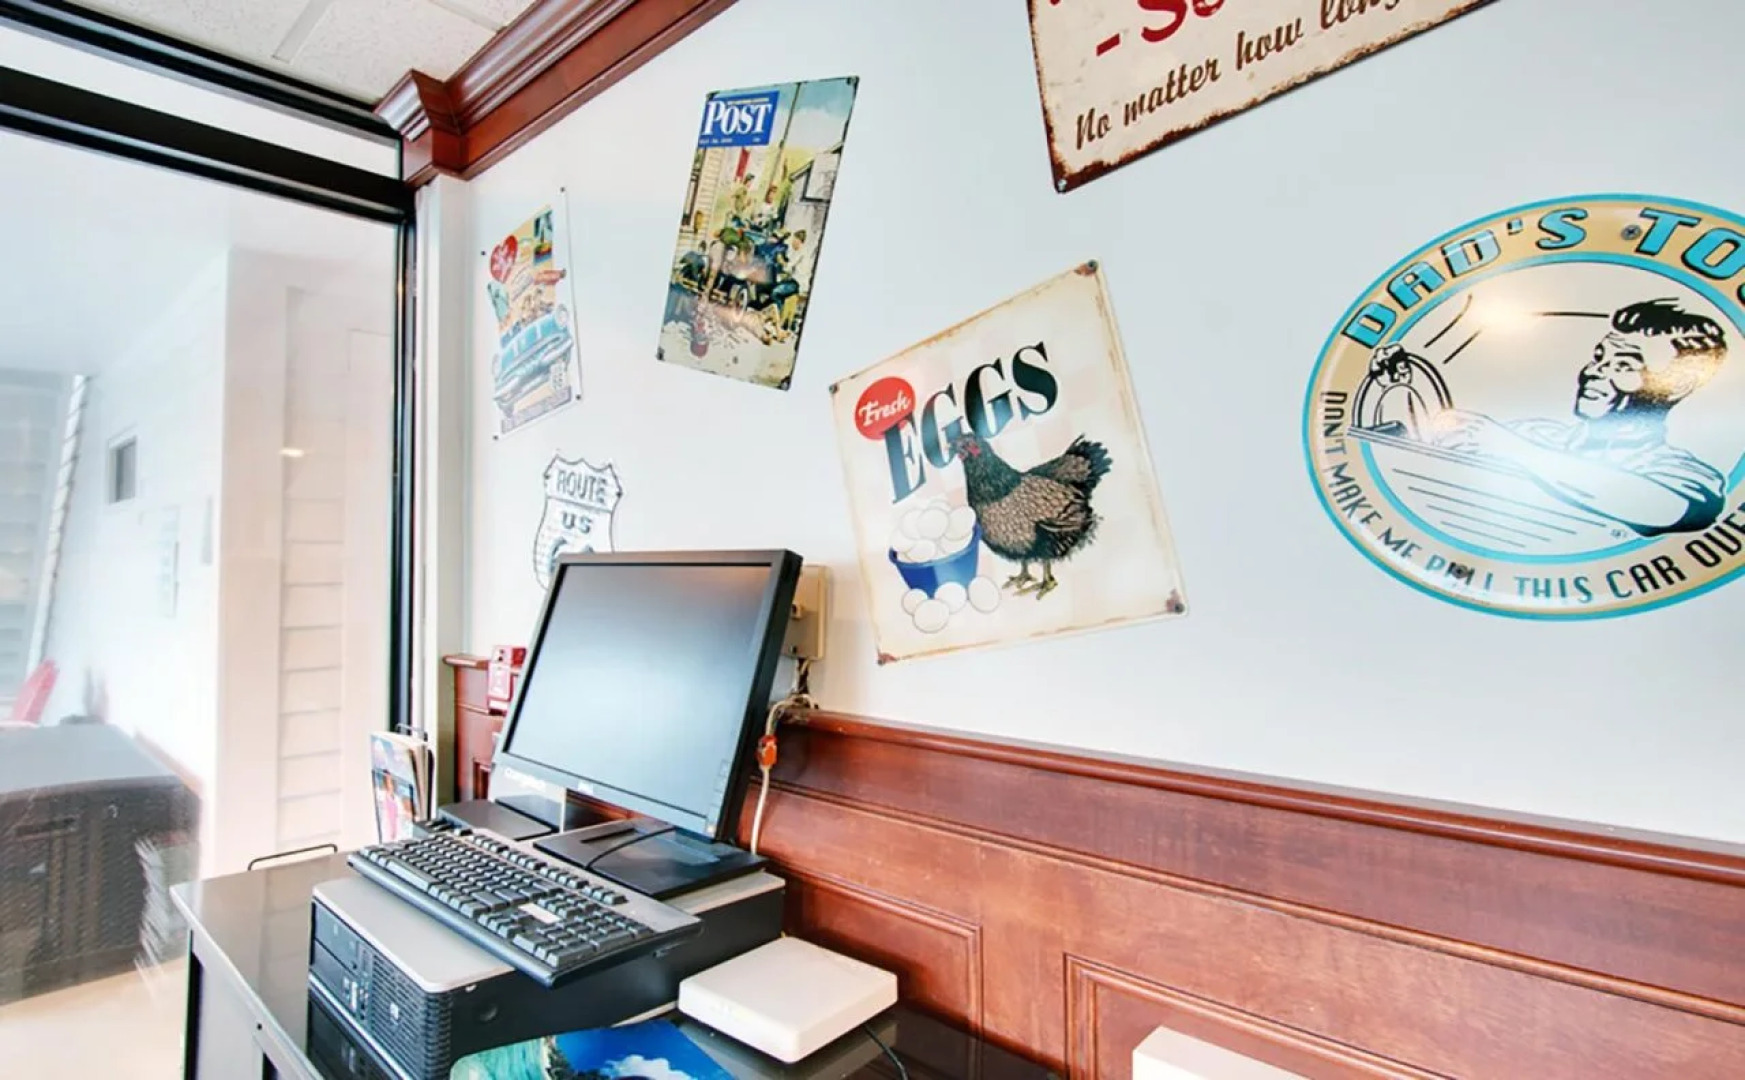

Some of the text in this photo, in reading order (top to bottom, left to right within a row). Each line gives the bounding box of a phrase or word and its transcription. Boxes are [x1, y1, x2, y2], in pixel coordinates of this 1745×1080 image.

[701, 100, 773, 135] POST
[1076, 107, 1112, 150] No
[1123, 58, 1221, 127] matter
[1236, 18, 1304, 71] how
[1340, 207, 1745, 350] DAD'S TO
[858, 389, 912, 427] Fresh
[882, 341, 1059, 505] EGGS
[556, 469, 607, 504] ROUTE
[561, 511, 592, 534] US
[1322, 461, 1383, 524] MAKE
[1377, 527, 1423, 559] ME
[1514, 575, 1593, 603] THIS
[1606, 554, 1687, 599] CAR
